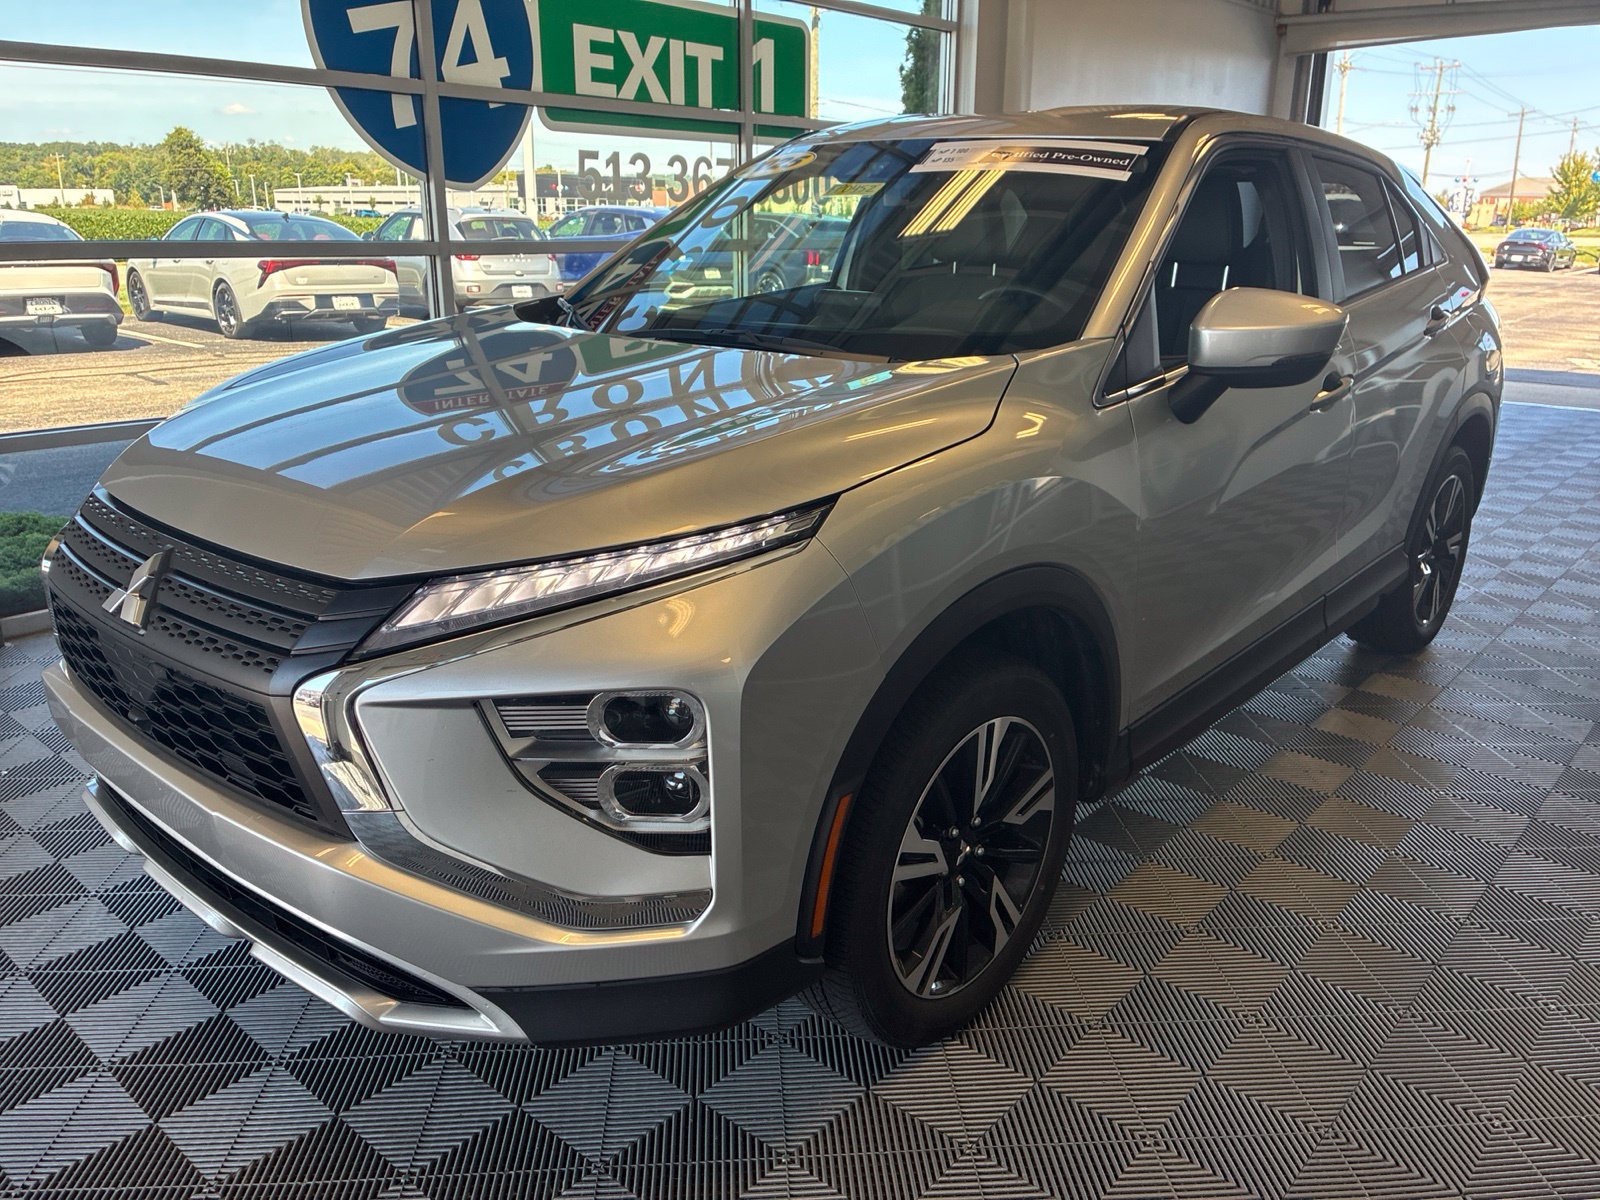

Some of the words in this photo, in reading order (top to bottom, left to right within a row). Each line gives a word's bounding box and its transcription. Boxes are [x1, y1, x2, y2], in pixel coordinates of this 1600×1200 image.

[347, 0, 511, 129] 74
[573, 22, 724, 109] EXIT
[752, 37, 775, 113] 1
[1052, 151, 1130, 167] Pre-Owned
